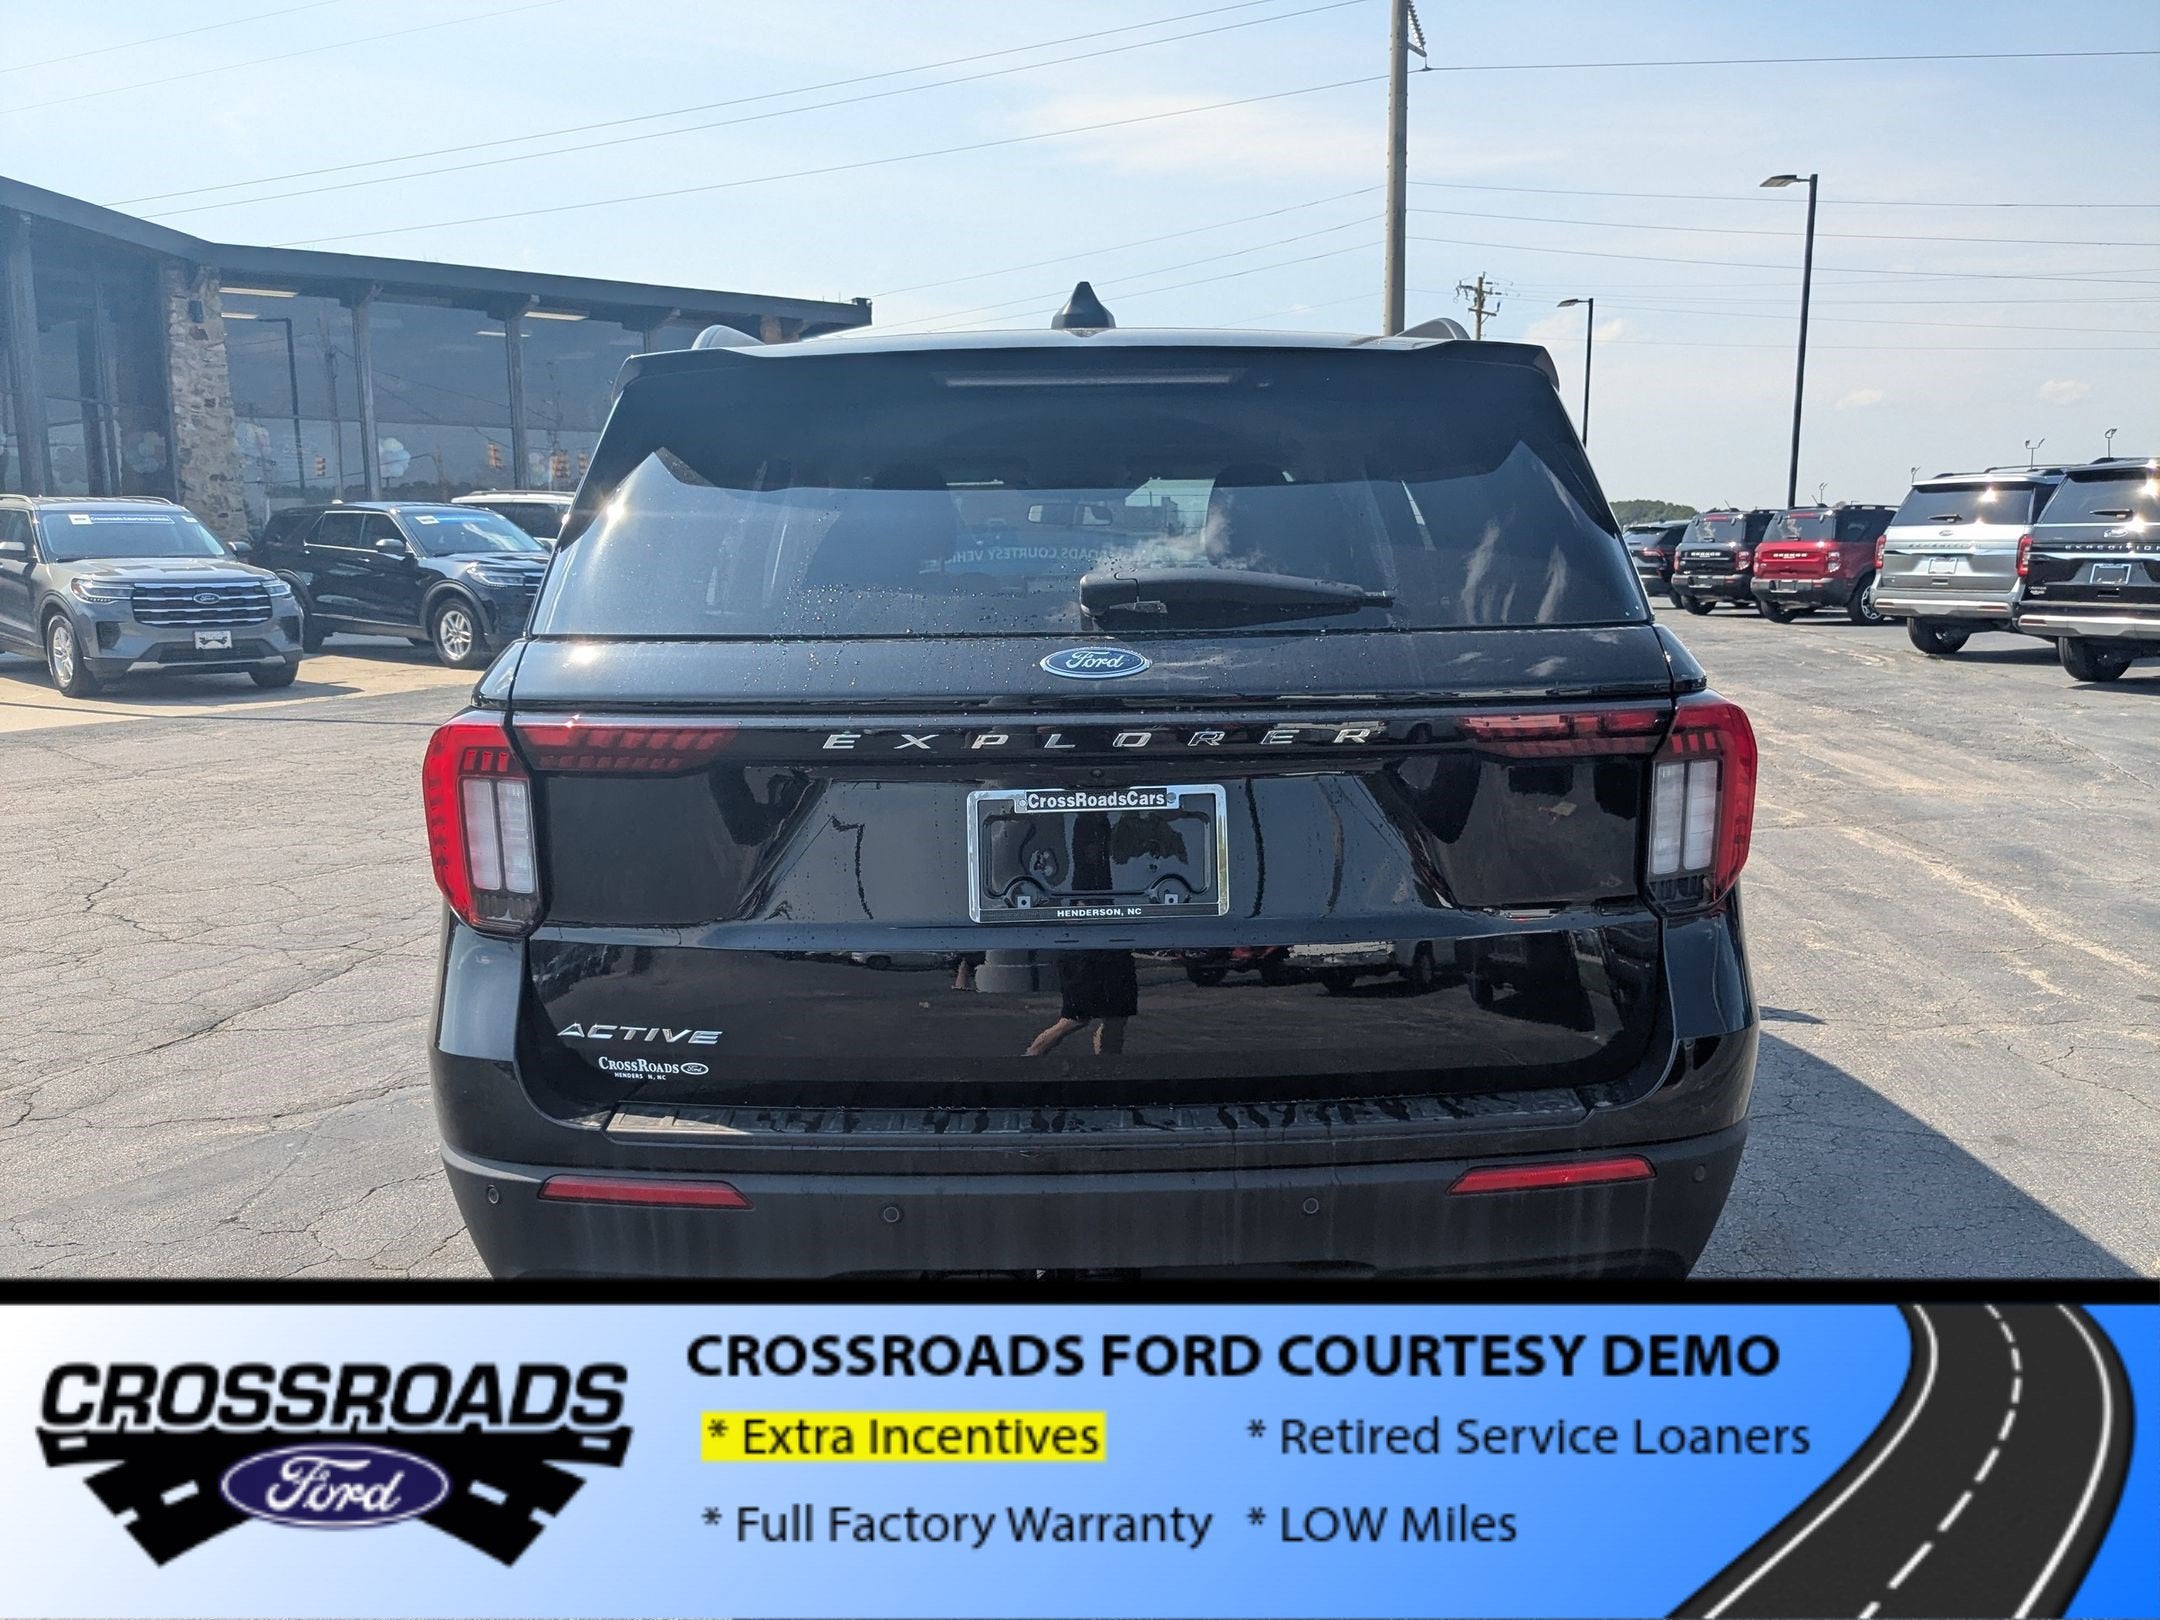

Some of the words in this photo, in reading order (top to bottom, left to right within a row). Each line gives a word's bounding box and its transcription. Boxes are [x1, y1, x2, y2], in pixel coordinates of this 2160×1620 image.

[1065, 650, 1125, 669] Ford
[822, 727, 1372, 750] EXPLORER
[1027, 790, 1165, 809] CrossRoadsCars
[1057, 908, 1124, 917] HENDERSON,
[557, 1022, 723, 1045] ACTIVE
